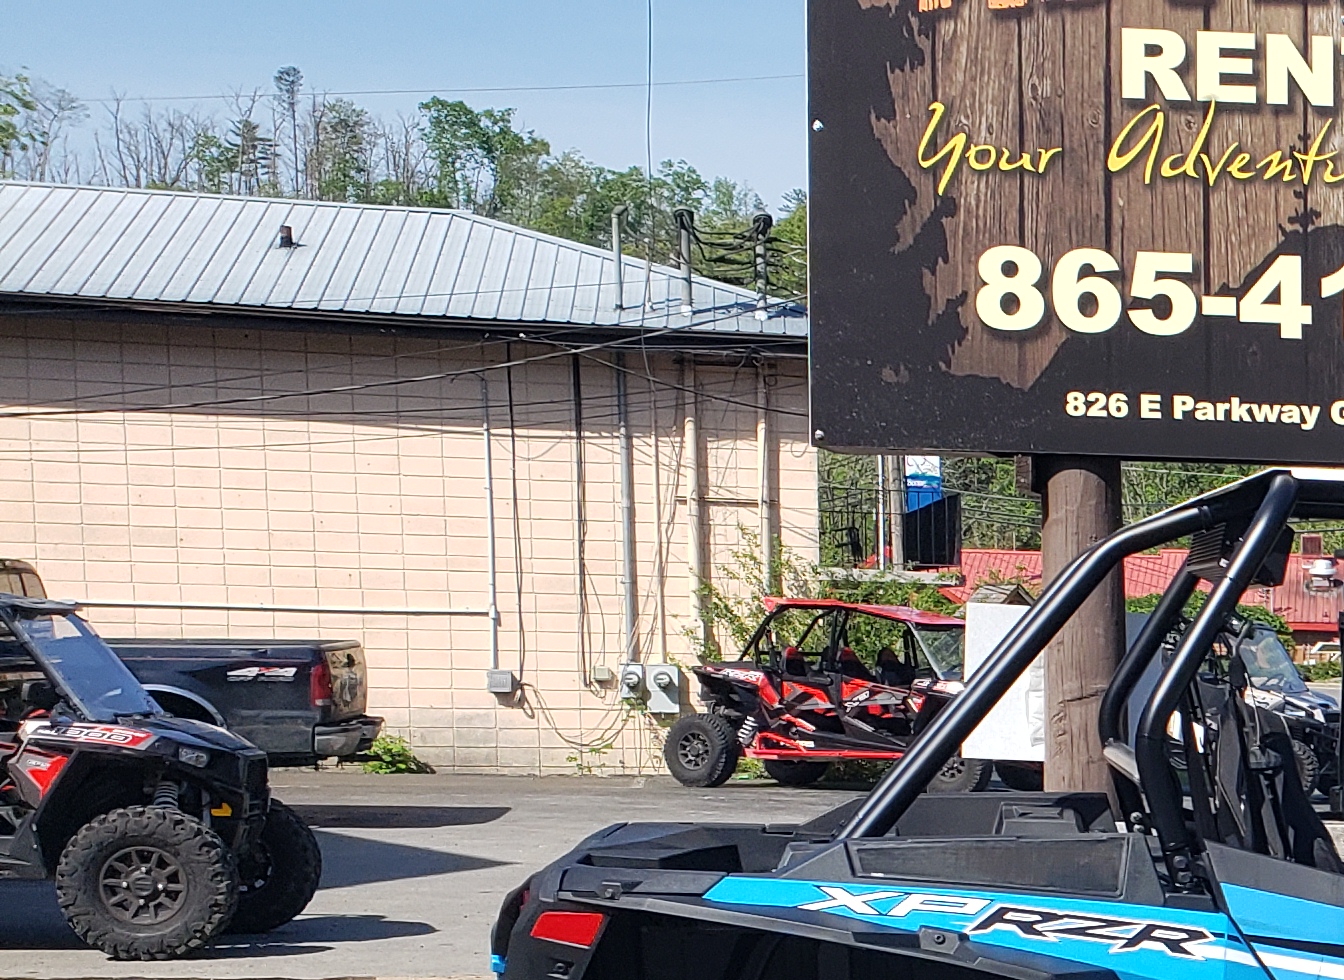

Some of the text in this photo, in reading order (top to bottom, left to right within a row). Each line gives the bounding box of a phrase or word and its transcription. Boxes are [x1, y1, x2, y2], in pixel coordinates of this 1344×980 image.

[917, 102, 1062, 196] Your
[1065, 391, 1129, 418] 826
[1140, 393, 1162, 419] E
[1172, 395, 1321, 430] Parkway
[798, 886, 995, 916] XP
[965, 905, 1215, 961] RZR
